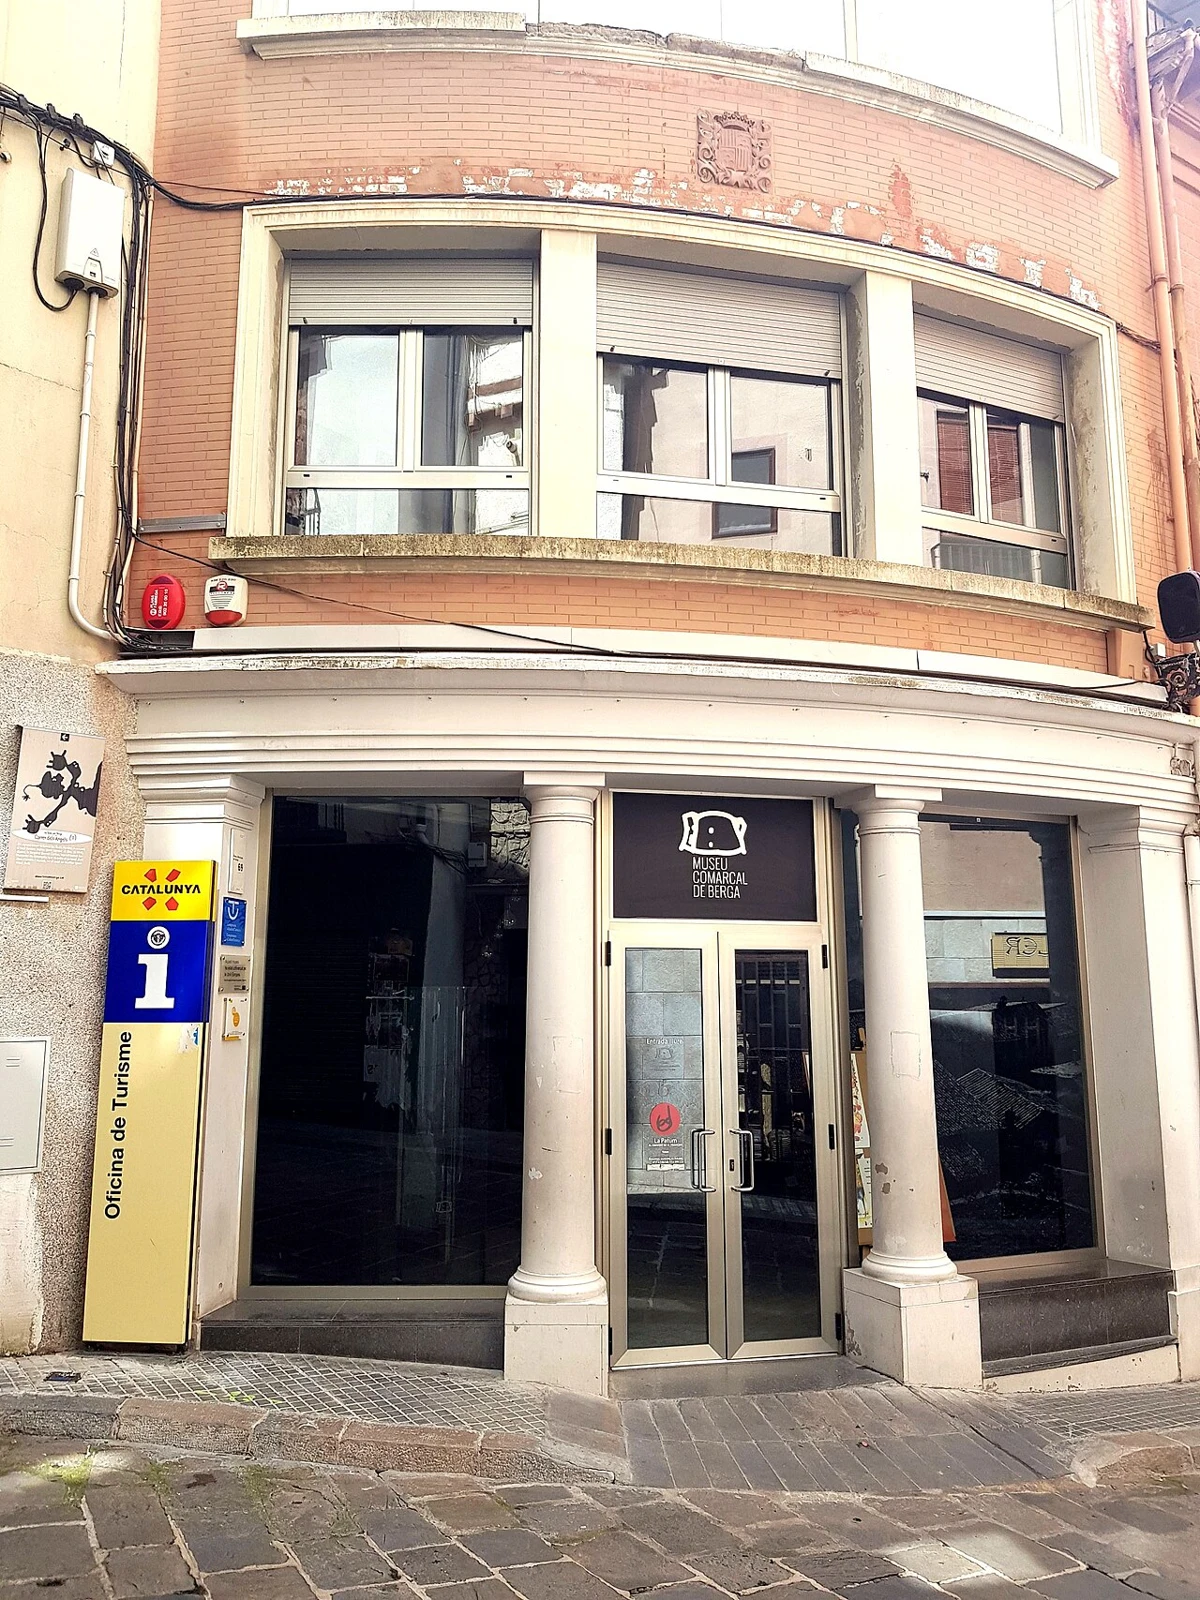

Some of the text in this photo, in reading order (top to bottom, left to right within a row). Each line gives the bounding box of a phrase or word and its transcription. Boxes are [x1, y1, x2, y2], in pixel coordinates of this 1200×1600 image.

[692, 856, 728, 870] MUSEU
[692, 870, 748, 885] COMARCAL
[121, 884, 201, 894] CATALUNYA
[693, 884, 741, 899] DE BERGA
[104, 1031, 132, 1220] Oficina de Turisme
